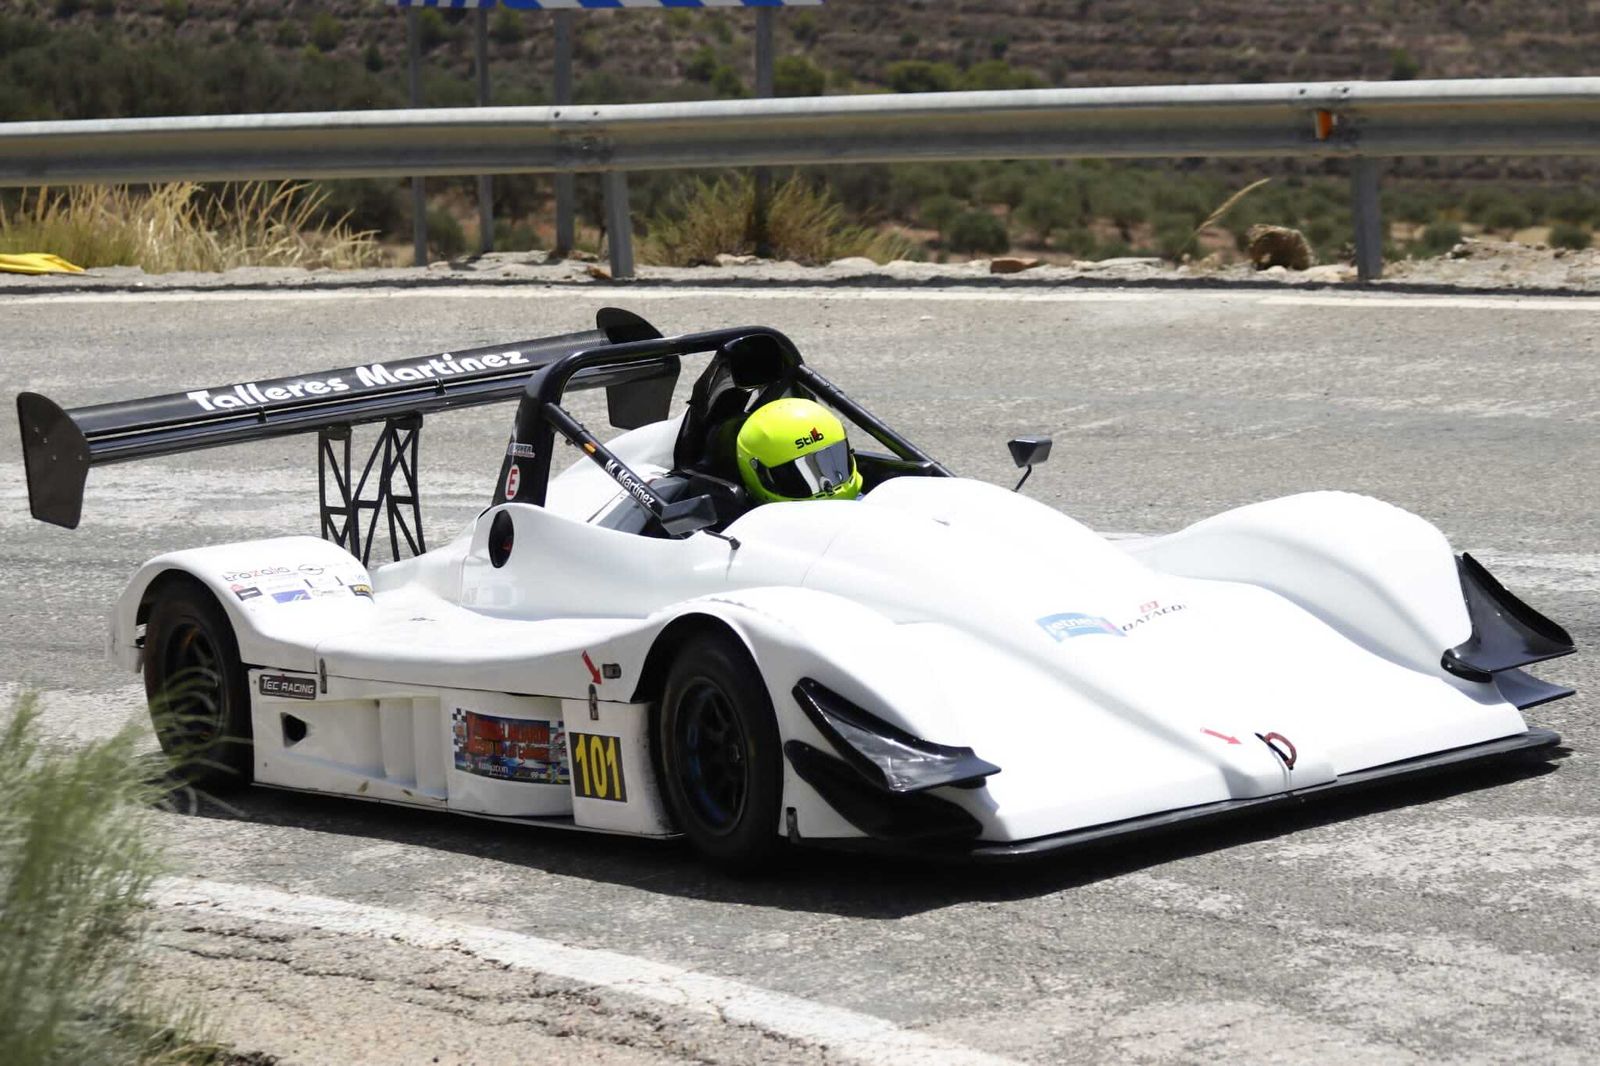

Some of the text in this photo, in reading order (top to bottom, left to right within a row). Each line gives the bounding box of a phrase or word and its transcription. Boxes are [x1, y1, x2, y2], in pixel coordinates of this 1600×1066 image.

[186, 351, 530, 412] Talleres Martinez
[795, 427, 824, 449] Stilo
[507, 468, 518, 496] E
[262, 676, 315, 694] TEC RACING
[575, 734, 622, 800] 101
